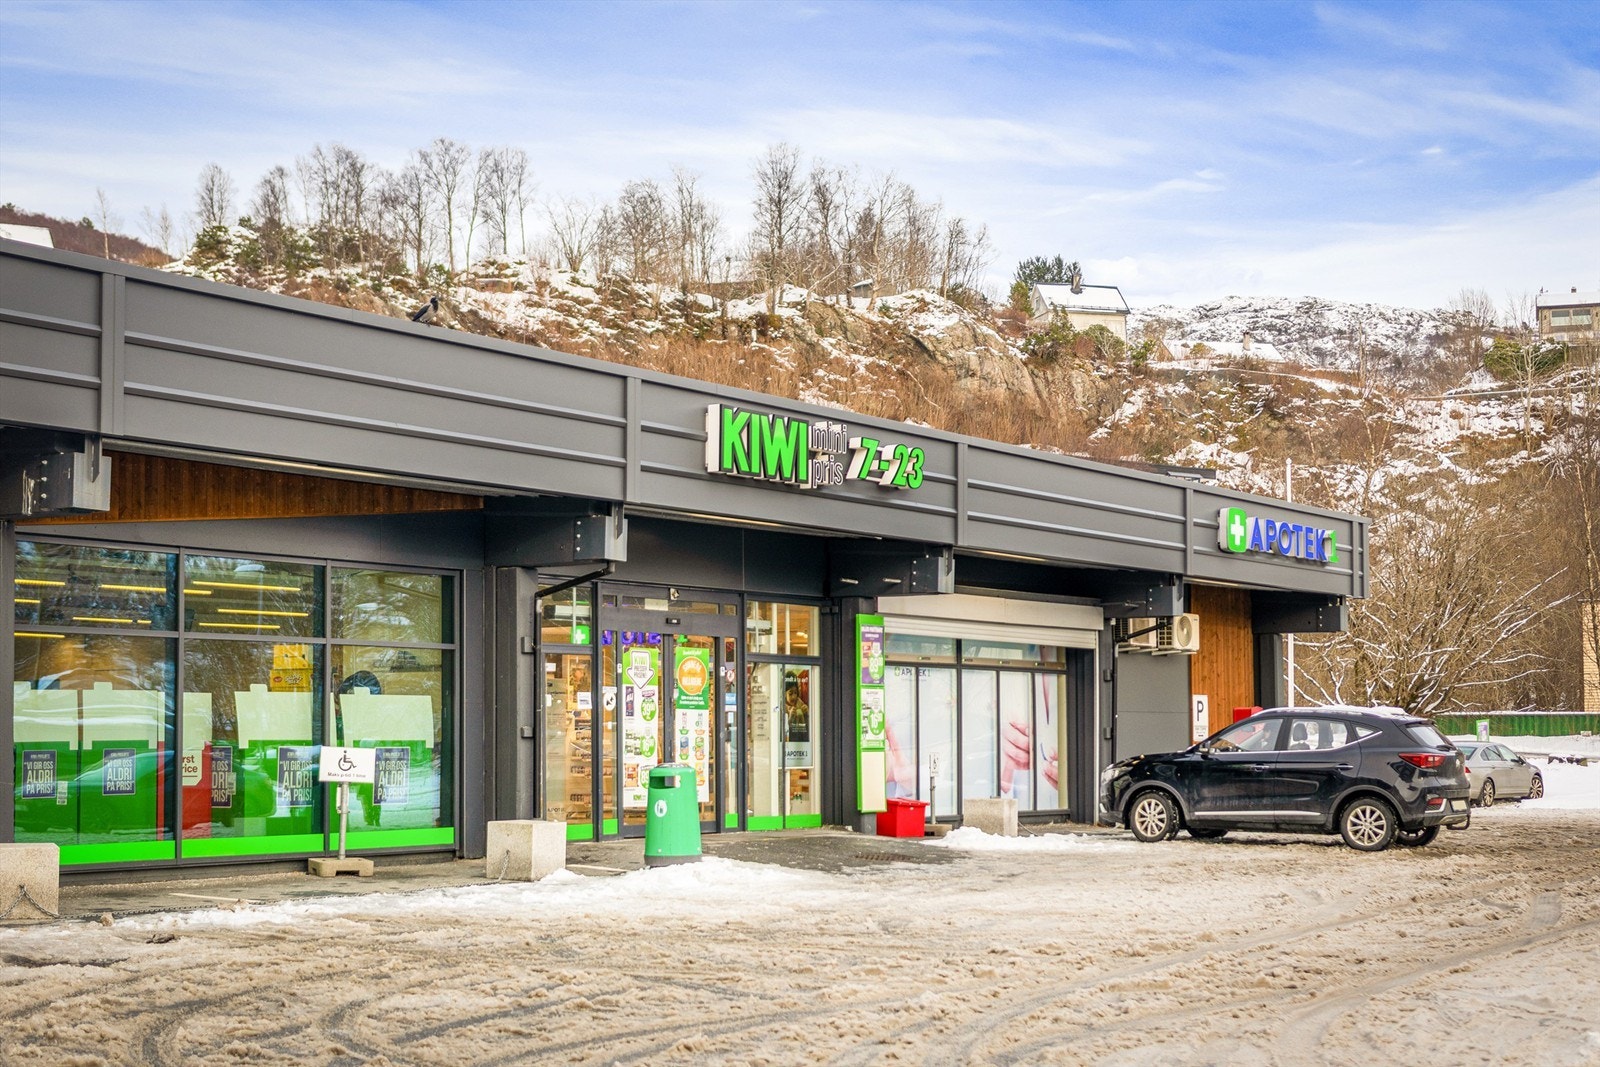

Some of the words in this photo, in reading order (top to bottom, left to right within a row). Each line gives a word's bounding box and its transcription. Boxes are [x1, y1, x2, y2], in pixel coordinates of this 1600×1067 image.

[718, 404, 810, 484] KIWI
[812, 421, 847, 455] mini
[857, 436, 925, 490] 7-23
[812, 456, 843, 489] pris
[1250, 516, 1328, 563] APOTEK
[1329, 530, 1339, 563] 1
[1196, 700, 1204, 721] P
[43, 760, 54, 769] OSS
[122, 759, 132, 768] OSS
[182, 755, 195, 763] rst
[217, 761, 229, 770] OSS
[290, 761, 301, 771] GIR
[386, 760, 396, 770] GIR
[397, 760, 407, 770] OSS
[107, 767, 132, 781] ALDRI
[182, 764, 198, 773] rice
[26, 769, 53, 784] ALDRI
[211, 772, 228, 788] DRI
[282, 770, 313, 788] ALDRI
[379, 770, 406, 787] ALDRI
